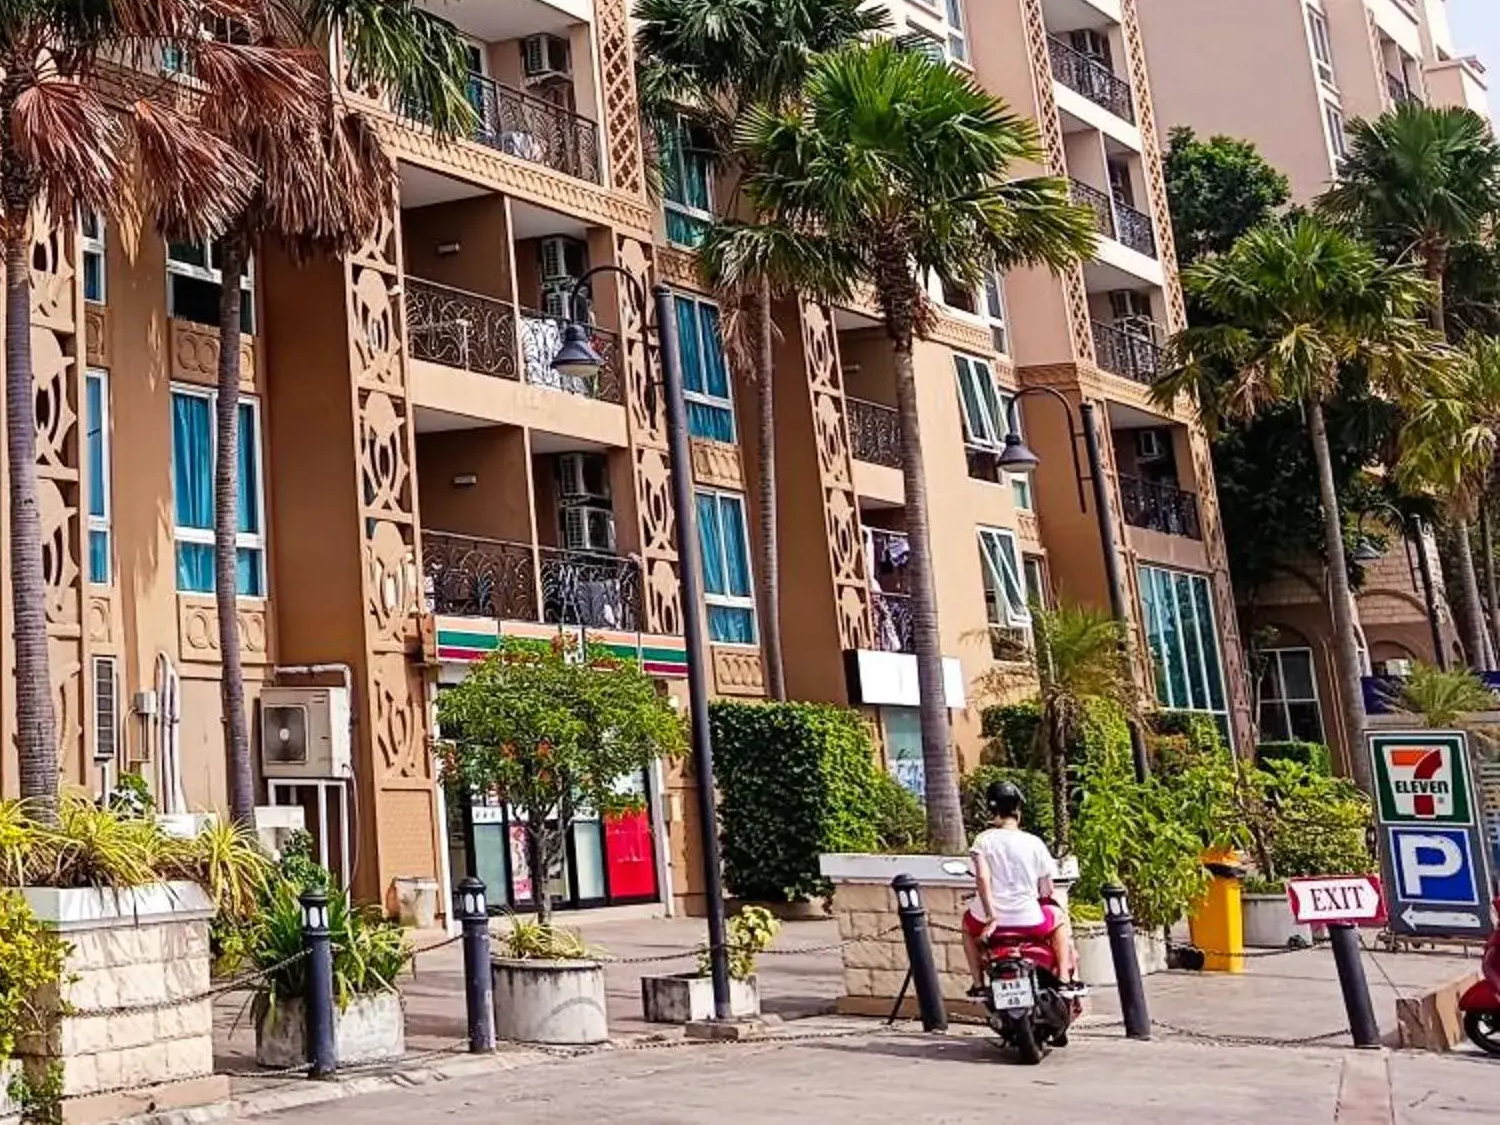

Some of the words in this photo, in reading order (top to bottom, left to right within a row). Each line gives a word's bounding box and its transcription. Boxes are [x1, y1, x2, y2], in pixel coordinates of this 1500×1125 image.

[1390, 748, 1443, 816] 7
[1398, 834, 1463, 896] P
[1310, 886, 1365, 912] EXIT
